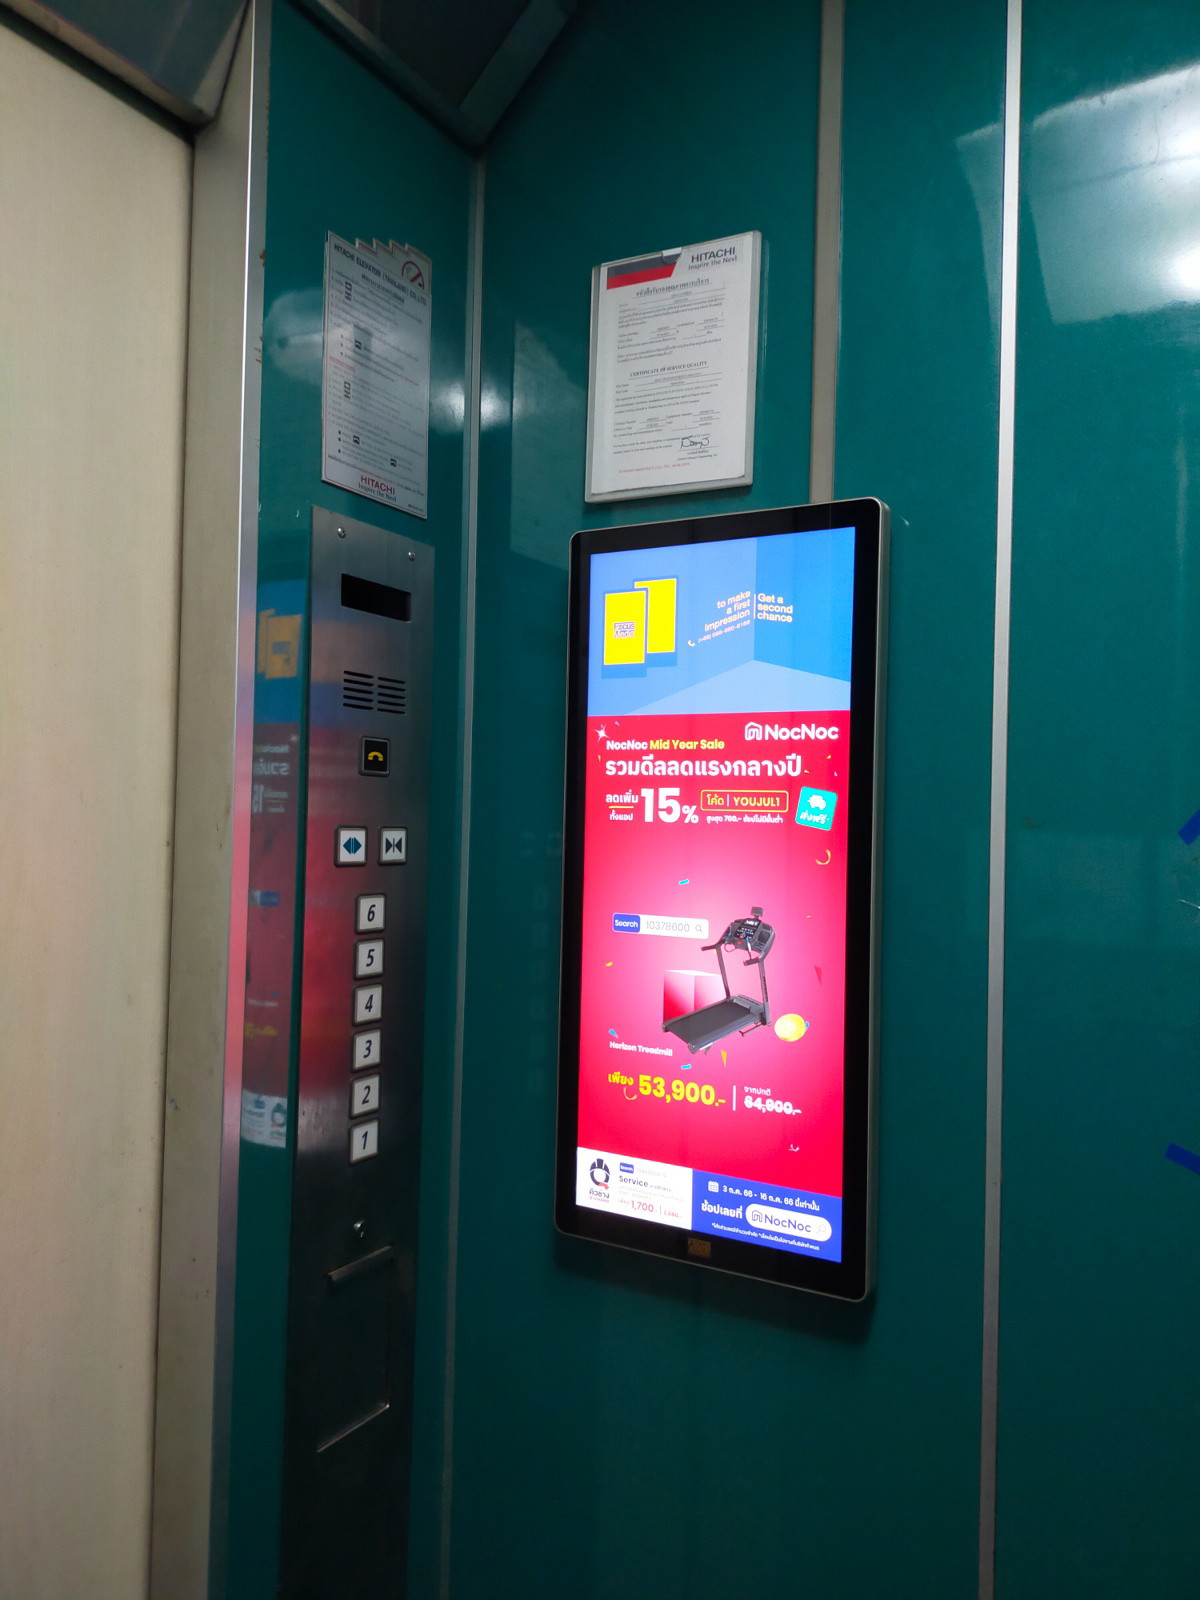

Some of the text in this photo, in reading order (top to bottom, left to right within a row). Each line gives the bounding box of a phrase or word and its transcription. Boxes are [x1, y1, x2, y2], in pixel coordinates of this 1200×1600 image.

[334, 243, 355, 262] HITACHI
[356, 257, 381, 278] ELEVATOR
[688, 255, 738, 271] Inspire the Next
[690, 246, 736, 263] HITACHI
[629, 367, 659, 377] CERTIFICATE
[666, 363, 686, 371] SERVICE
[686, 360, 708, 369] QUALITY
[360, 474, 395, 495] HITACHI
[717, 590, 751, 608] to make
[733, 600, 750, 613] first
[757, 593, 784, 604] Get a
[757, 603, 793, 614] second
[757, 611, 793, 623] chance
[704, 609, 751, 632] impression
[764, 723, 839, 741] NocNoc
[606, 738, 726, 751] NocNoc Mid Year Sale
[605, 753, 802, 777] รวมดีลลดแรงกลางปี
[605, 789, 639, 804] ลดเพิ่ม
[707, 793, 781, 808] โค้ด YOUJUL1
[367, 902, 376, 923] 6
[614, 919, 690, 933] Search 10378600
[366, 948, 375, 968] 5
[364, 993, 374, 1014] 4
[363, 1039, 372, 1059] 3
[609, 1042, 673, 1057] Horizon Treadmill
[362, 1085, 372, 1106] 2
[608, 1071, 726, 1107] เพียง 53,900.-
[360, 1130, 368, 1150] 1
[618, 1175, 648, 1188] Service
[701, 1199, 812, 1233] ช้อปเลยที่ NocNoc
